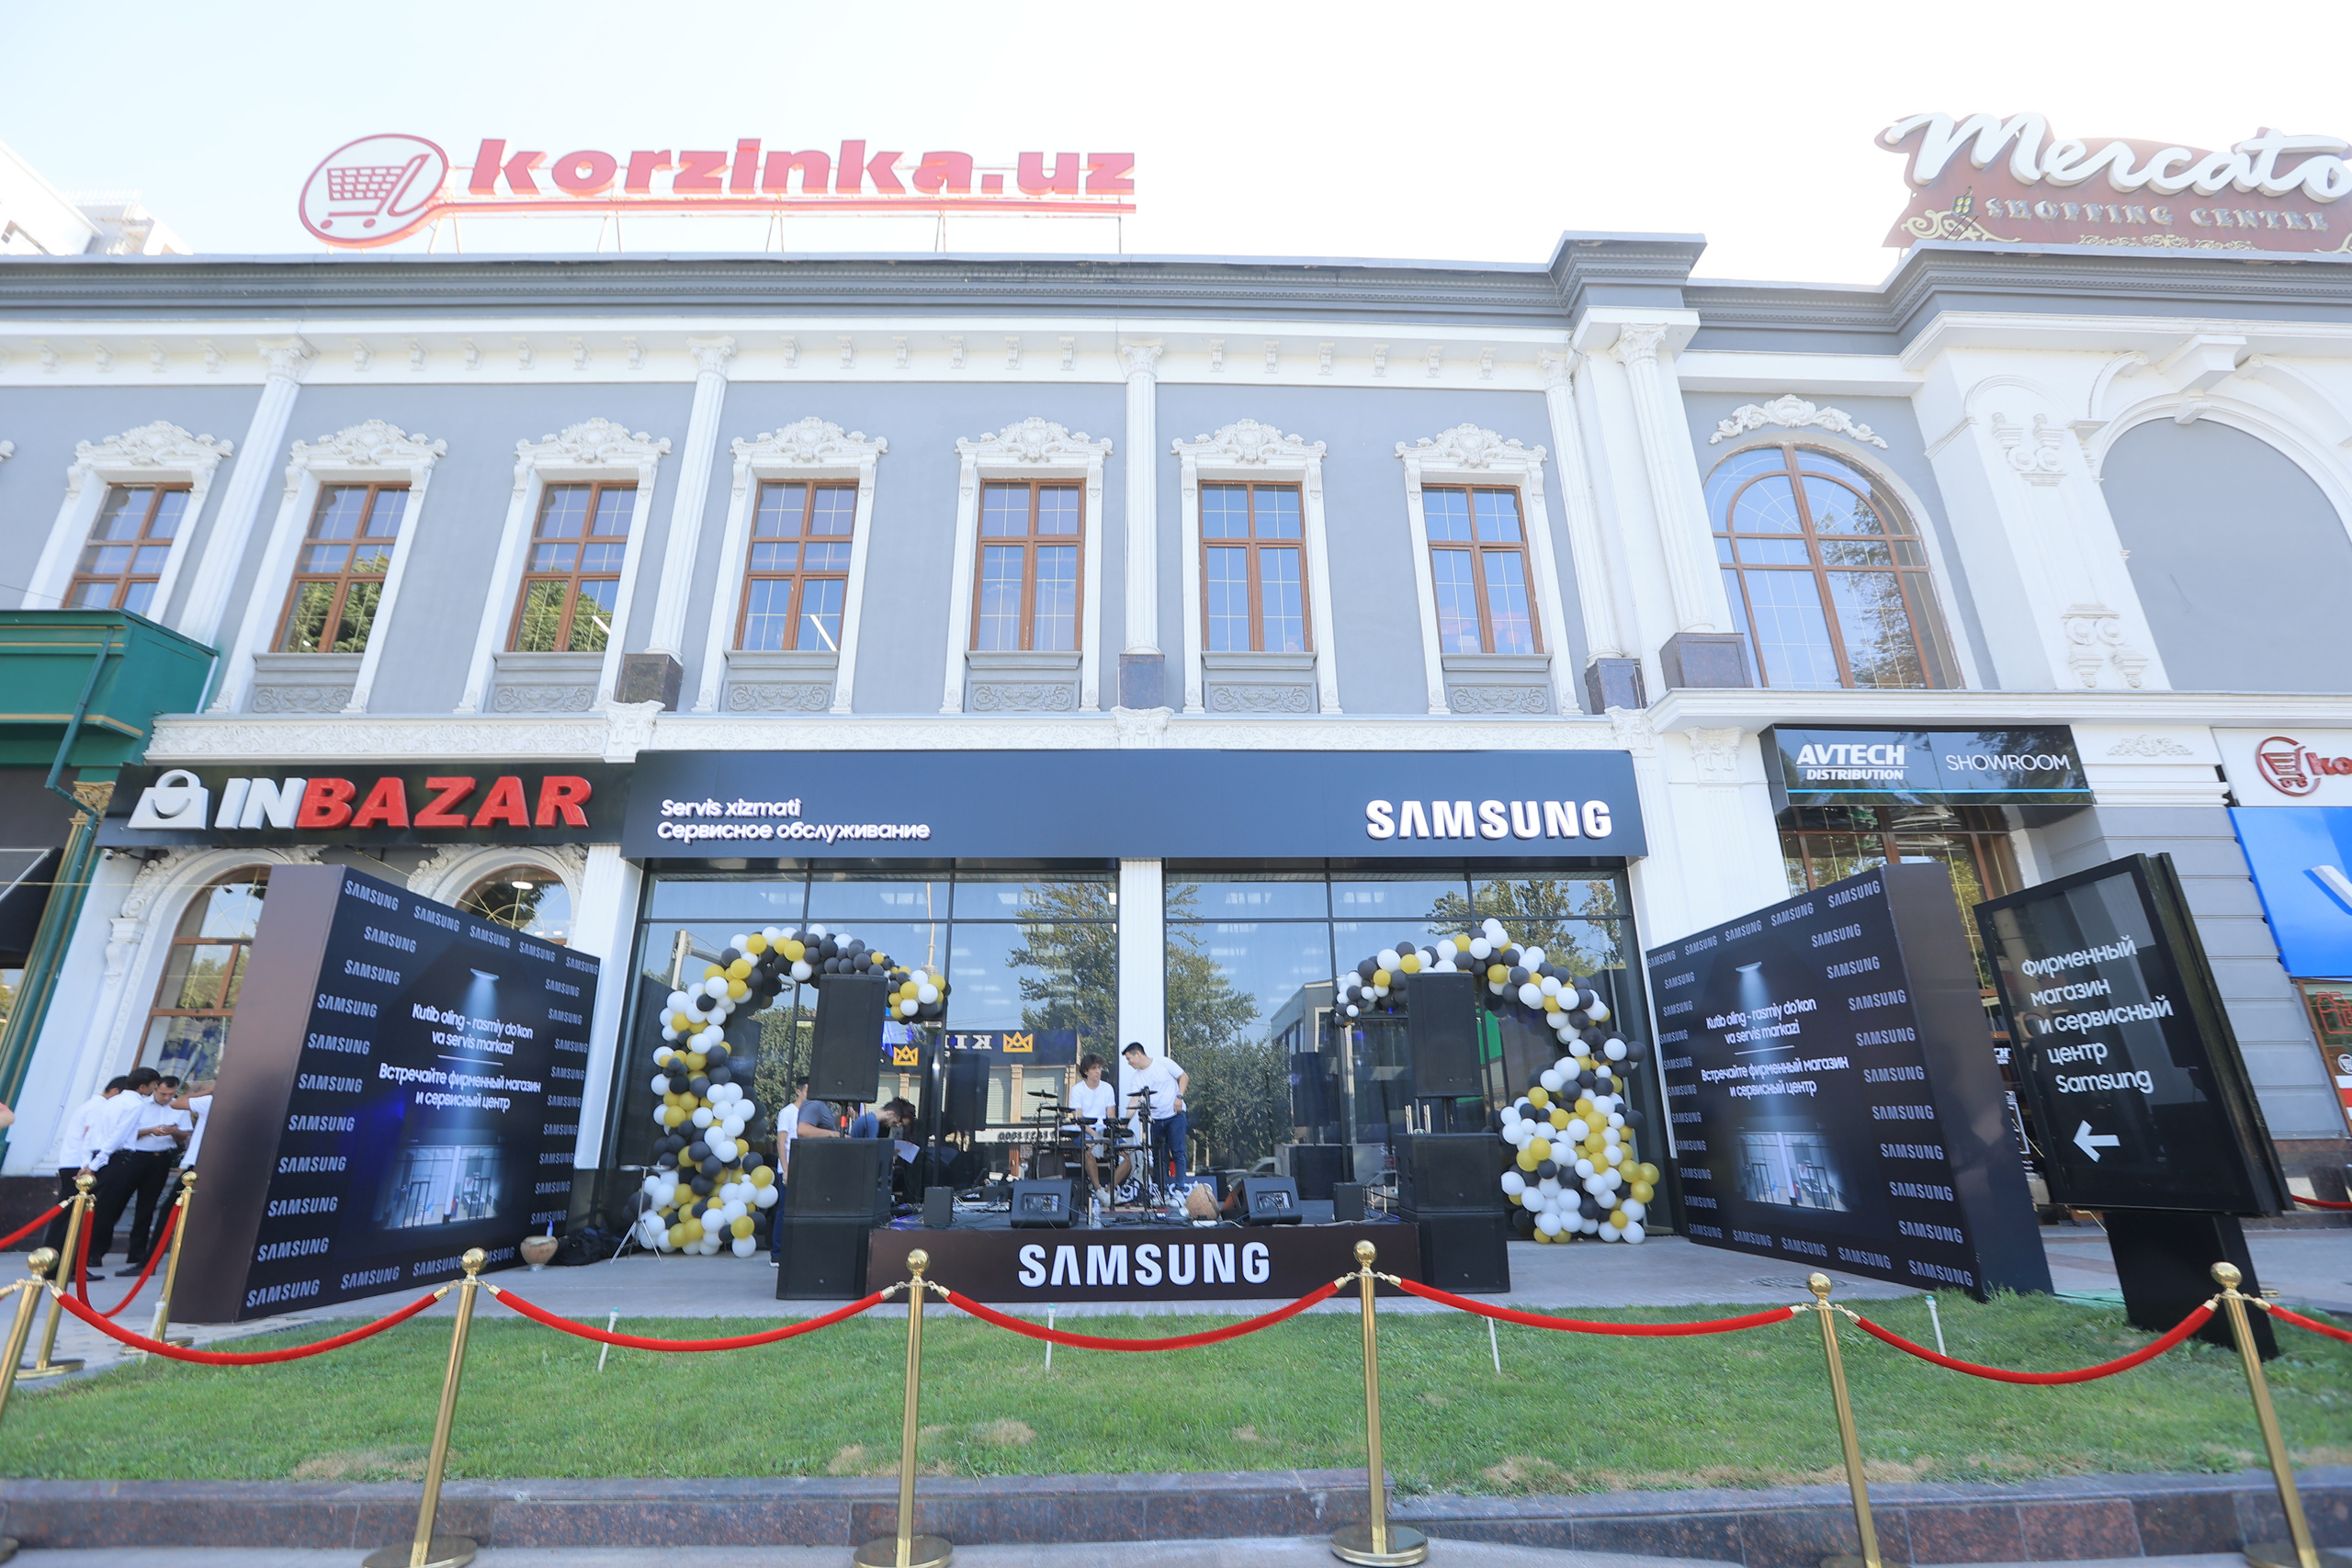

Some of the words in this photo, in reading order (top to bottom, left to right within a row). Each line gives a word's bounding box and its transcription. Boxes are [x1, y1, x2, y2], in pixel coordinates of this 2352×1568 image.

[468, 139, 1136, 196] korzinka.uz
[1883, 111, 2352, 203] Mercato
[1984, 197, 2174, 226] SHOPPING
[2190, 207, 2330, 231] CENTRE
[1796, 743, 1906, 766] AVTECH
[1945, 753, 2072, 772] SHOWROOM
[1806, 769, 1905, 781] DISTRIBUTION
[214, 774, 593, 830] INBAZAR
[660, 797, 724, 818] Servis
[725, 797, 803, 818] xizmati
[1365, 799, 1613, 840] SAMSUNG
[656, 821, 775, 845] Сервисное
[775, 821, 932, 845] обслуживание
[345, 880, 399, 911] SAMSUNG
[1828, 881, 1881, 908] SAMSUNG
[414, 905, 459, 931] SAMSUNG
[1771, 903, 1814, 926] SAMSUNG
[364, 926, 416, 953] SAMSUNG
[469, 925, 511, 948] SAMSUNG
[1725, 919, 1762, 942] SAMSUNG
[1812, 924, 1861, 947] SAMSUNG
[519, 942, 556, 962] SAMSUNG
[1685, 935, 1718, 956] SAMSUNG
[2021, 934, 2138, 978] Фирменный
[566, 956, 599, 976] SAMSUNG
[1647, 950, 1676, 968] SAMSUNG
[1826, 956, 1880, 979] SAMSUNG
[345, 960, 401, 986] SAMSUNG
[1664, 972, 1696, 989] SAMSUNG
[545, 978, 581, 998] SAMSUNG
[2030, 978, 2112, 1007] магазин
[318, 994, 378, 1018] SAMSUNG
[1663, 1000, 1693, 1016] SAMSUNG
[1849, 989, 1906, 1011] SAMSUNG
[412, 1003, 439, 1023] Kutib
[441, 1009, 465, 1032] oling
[472, 1019, 503, 1038] rasmiy
[548, 1009, 582, 1025] SAMSUNG
[1705, 1015, 1726, 1030] Kutib
[1726, 1010, 1747, 1027] oling
[1752, 1002, 1782, 1021] rasmiy
[2039, 1018, 2053, 1034] и
[2054, 994, 2174, 1034] сервисный
[1659, 1029, 1689, 1044] SAMSUNG
[1724, 1032, 1736, 1044] va
[1736, 1028, 1761, 1043] servis
[1762, 1019, 1801, 1040] markazi
[1856, 1028, 1916, 1046] SAMSUNG
[308, 1033, 370, 1055] SAMSUNG
[432, 1031, 446, 1045] va
[447, 1033, 475, 1049] servis
[476, 1040, 514, 1055] markazi
[555, 1038, 588, 1053] SAMSUNG
[2047, 1042, 2108, 1066] центр
[551, 1066, 585, 1080] SAMSUNG
[1663, 1056, 1692, 1070] SAMSUNG
[1701, 1065, 1747, 1084] Встречайте
[1748, 1057, 1803, 1080] фирменный
[1804, 1056, 1849, 1072] магазин
[299, 1074, 363, 1093] SAMSUNG
[379, 1062, 447, 1086] Встречайте
[448, 1070, 504, 1091] фирменный
[505, 1078, 542, 1093] магазин
[1864, 1066, 1925, 1083] SAMSUNG
[2054, 1069, 2154, 1094] Samsung
[1668, 1084, 1697, 1097] SAMSUNG
[1729, 1086, 1736, 1098] и
[1736, 1079, 1786, 1100] сервисный
[1786, 1080, 1817, 1097] центр
[415, 1091, 424, 1104] и
[424, 1091, 481, 1110] сервисный
[482, 1095, 511, 1113] центр
[547, 1095, 582, 1108] SAMSUNG
[1872, 1105, 1935, 1120] SAMSUNG
[288, 1114, 356, 1133] SAMSUNG
[1672, 1111, 1702, 1123] SAMSUNG
[542, 1123, 577, 1135] SAMSUNG
[1676, 1140, 1707, 1151] SAMSUNG
[1881, 1144, 1944, 1161] SAMSUNG
[278, 1156, 346, 1174] SAMSUNG
[538, 1153, 574, 1165] SAMSUNG
[1679, 1167, 1712, 1180] SAMSUNG
[535, 1181, 571, 1194] SAMSUNG
[1890, 1181, 1954, 1201] SAMSUNG
[268, 1197, 338, 1217] SAMSUNG
[1684, 1195, 1717, 1209] SAMSUNG
[531, 1210, 567, 1225] SAMSUNG
[1689, 1224, 1723, 1239] SAMSUNG
[1732, 1229, 1773, 1247] SAMSUNG
[1898, 1221, 1963, 1244] SAMSUNG
[257, 1236, 329, 1262] SAMSUNG
[1781, 1236, 1828, 1258] SAMSUNG
[1838, 1246, 1893, 1270] SAMSUNG
[412, 1255, 461, 1277] SAMSUNG
[1018, 1241, 1272, 1288] SAMSUNG
[1907, 1259, 1973, 1287] SAMSUNG
[340, 1266, 401, 1290] SAMSUNG
[246, 1279, 321, 1308] SAMSUNG
